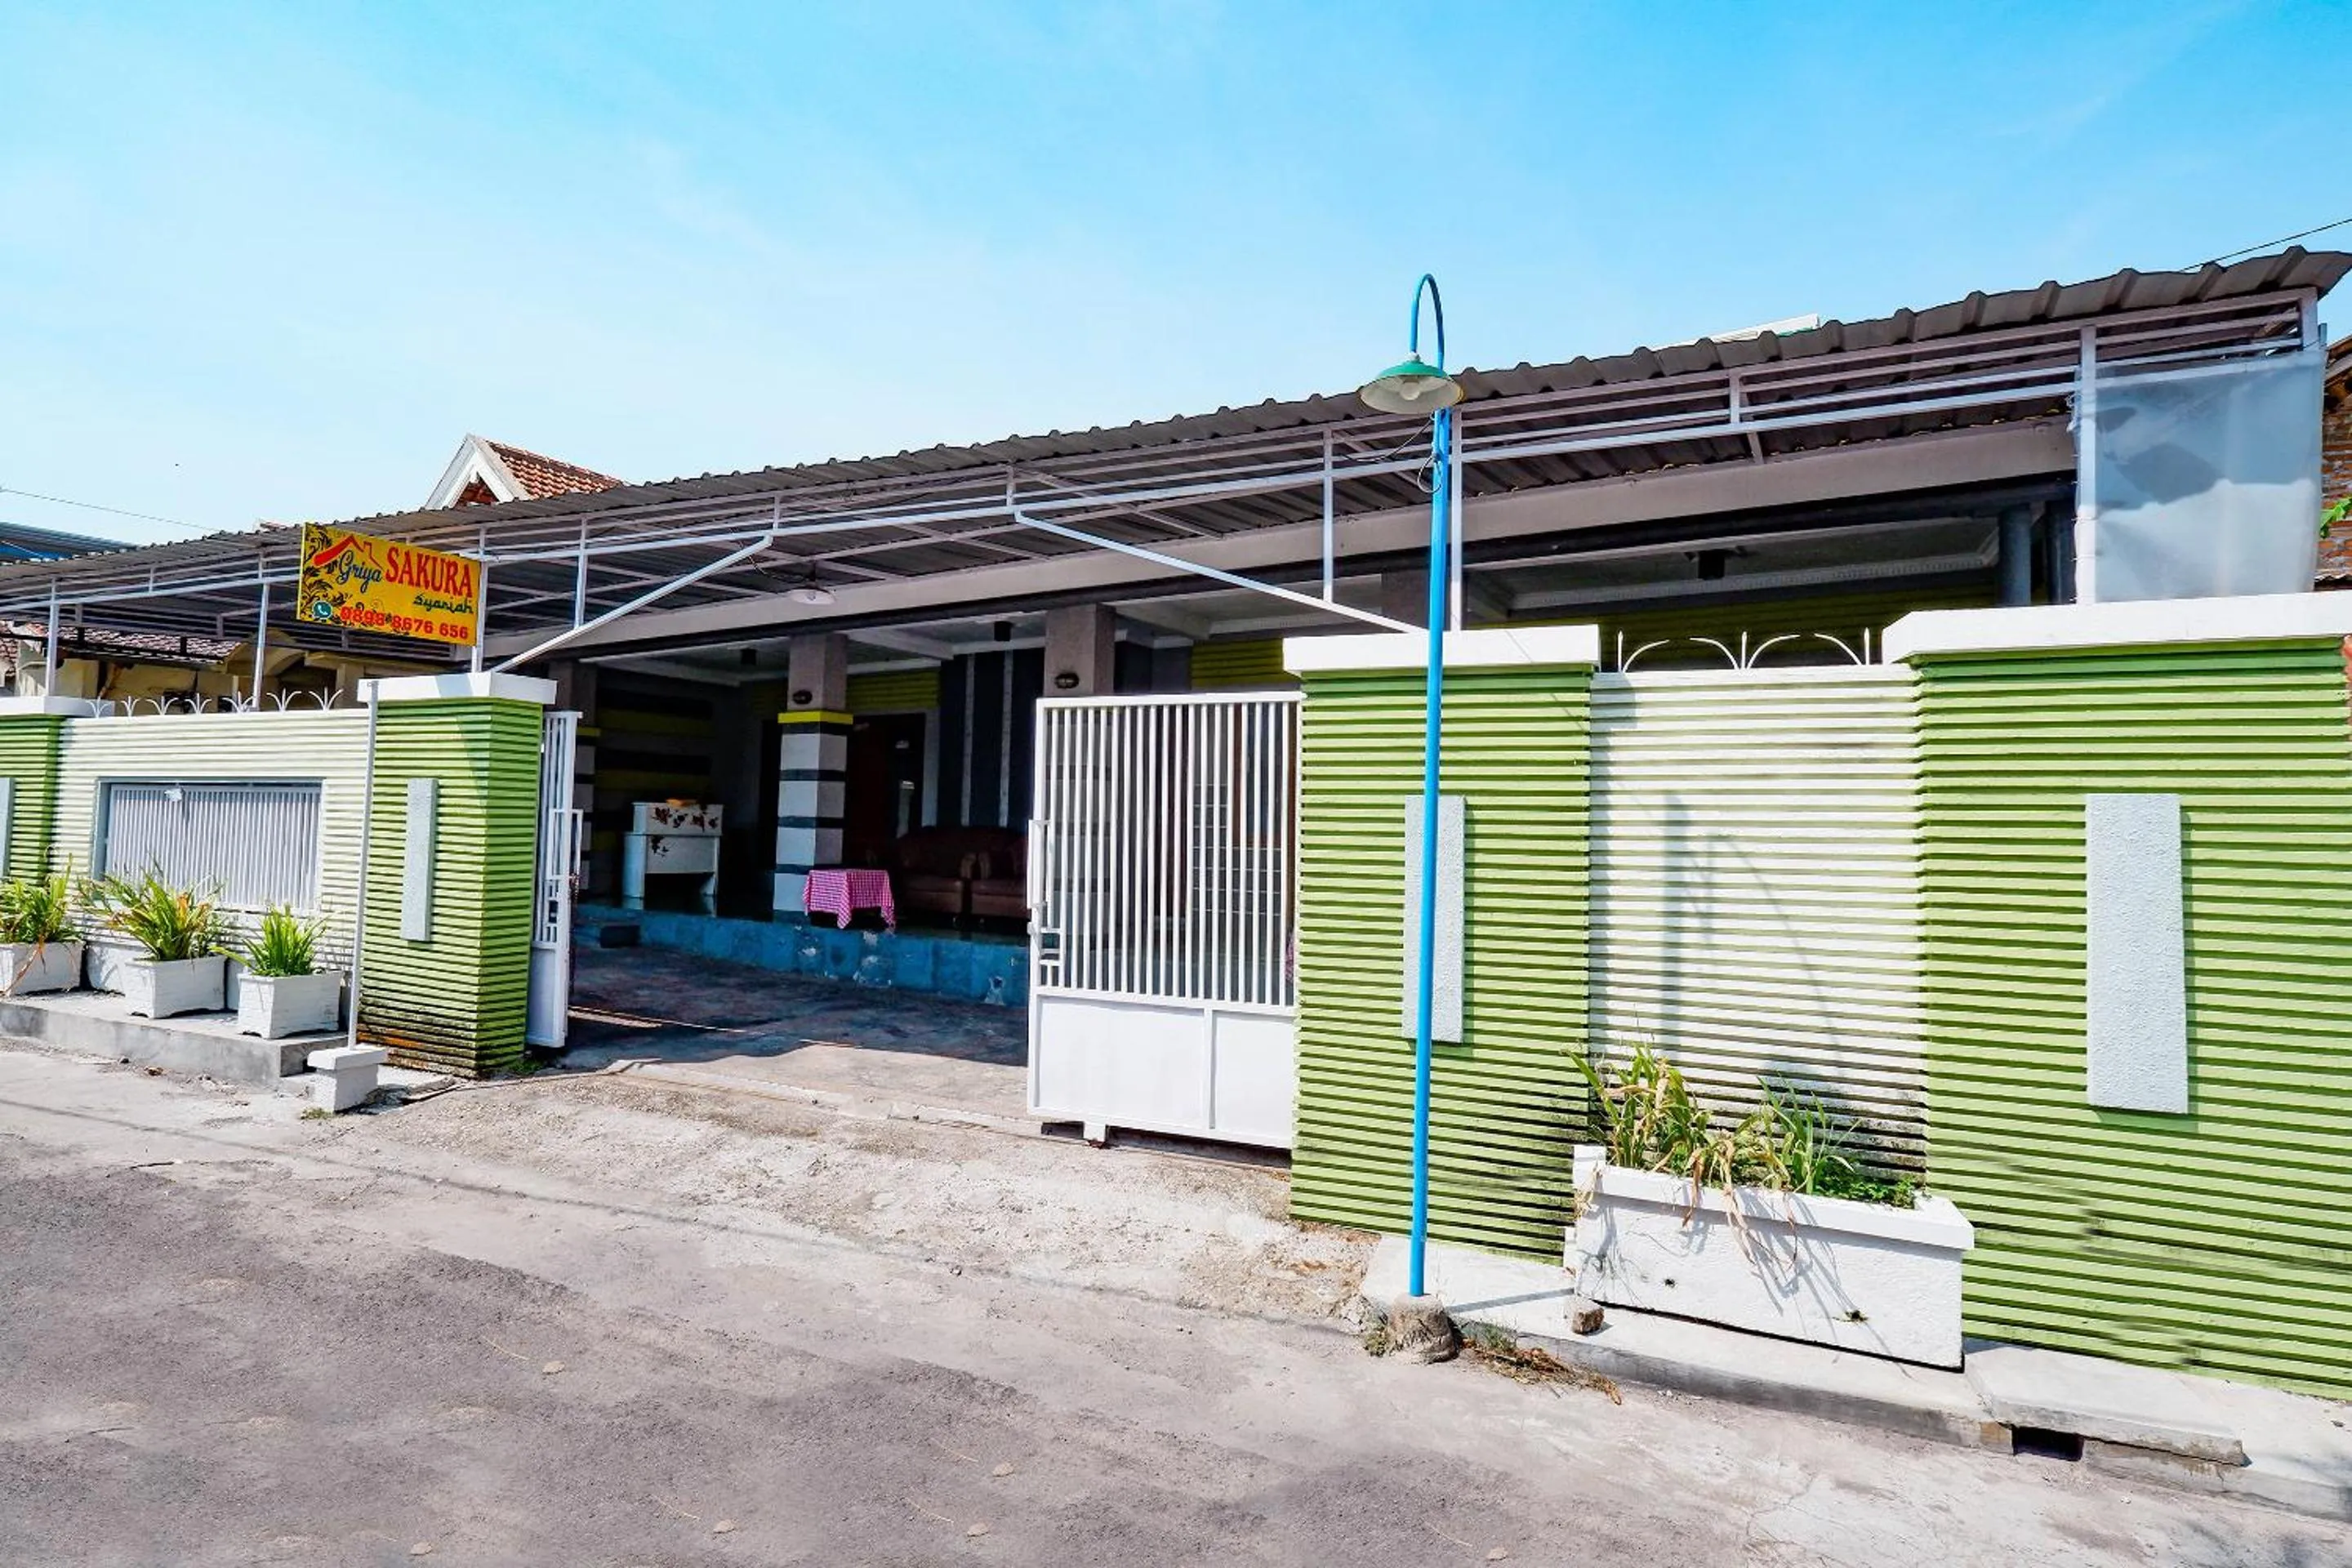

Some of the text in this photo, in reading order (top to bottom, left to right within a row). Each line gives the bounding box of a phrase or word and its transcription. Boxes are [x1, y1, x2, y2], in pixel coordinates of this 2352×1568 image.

[336, 546, 473, 598] Griya SAKURA
[339, 606, 468, 639] 0898 8676 656
